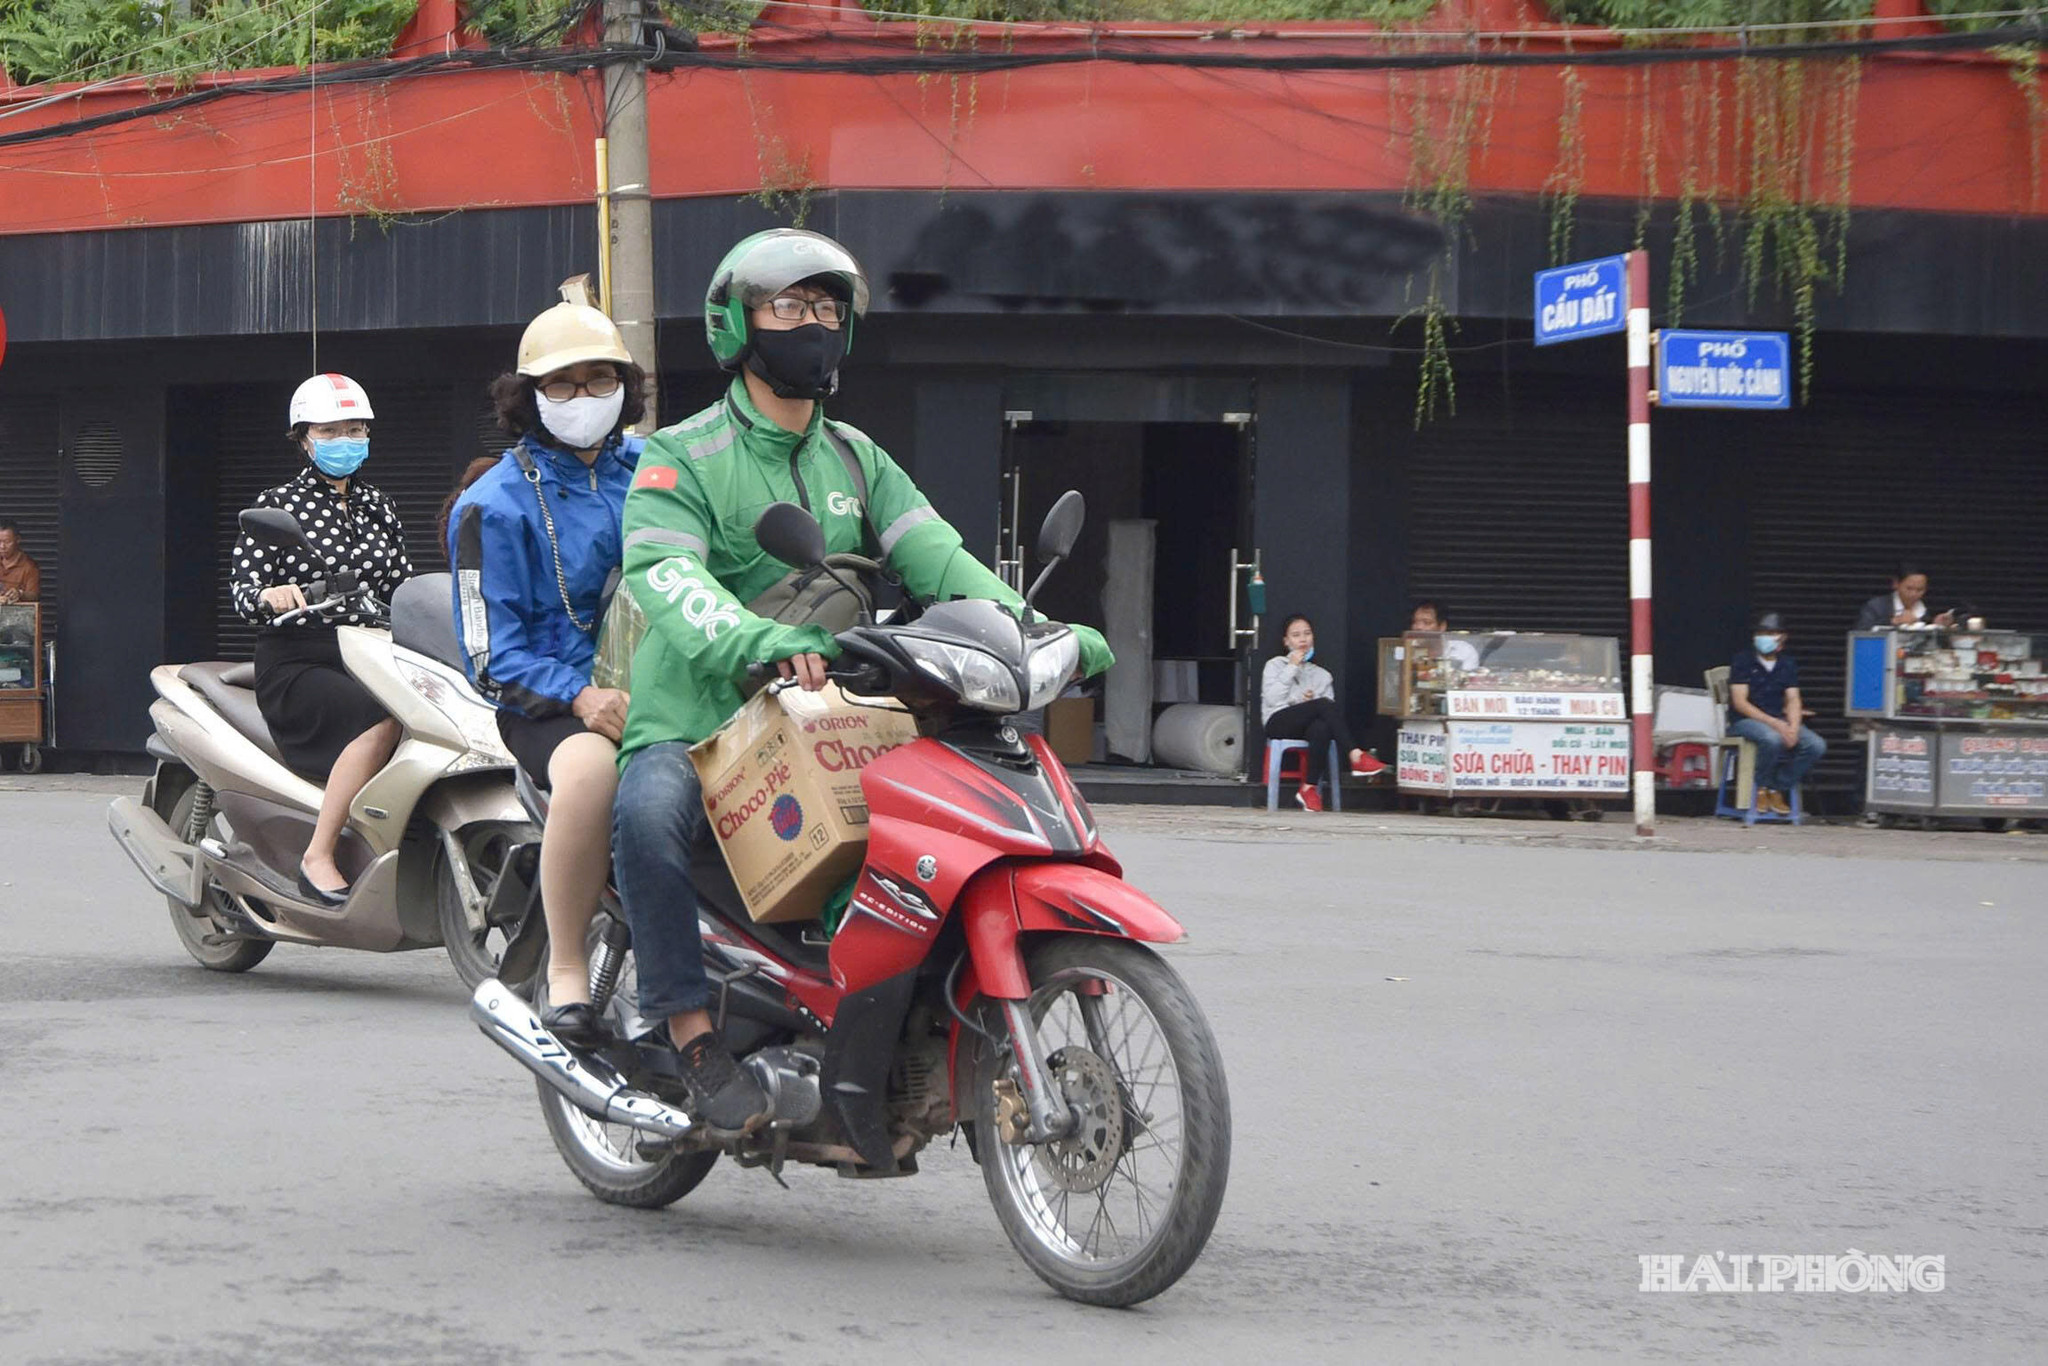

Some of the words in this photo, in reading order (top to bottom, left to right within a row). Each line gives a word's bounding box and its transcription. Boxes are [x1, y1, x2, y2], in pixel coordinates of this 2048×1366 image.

[1563, 264, 1599, 291] PHỐ
[1698, 337, 1748, 358] PHỐ
[819, 714, 869, 732] ORION
[1400, 731, 1427, 745] THAY
[1453, 744, 1485, 774] SỬA
[1490, 747, 1535, 774] CHỮA
[1552, 754, 1593, 775] THAY
[1597, 755, 1627, 776] PIN
[812, 828, 826, 845] 12
